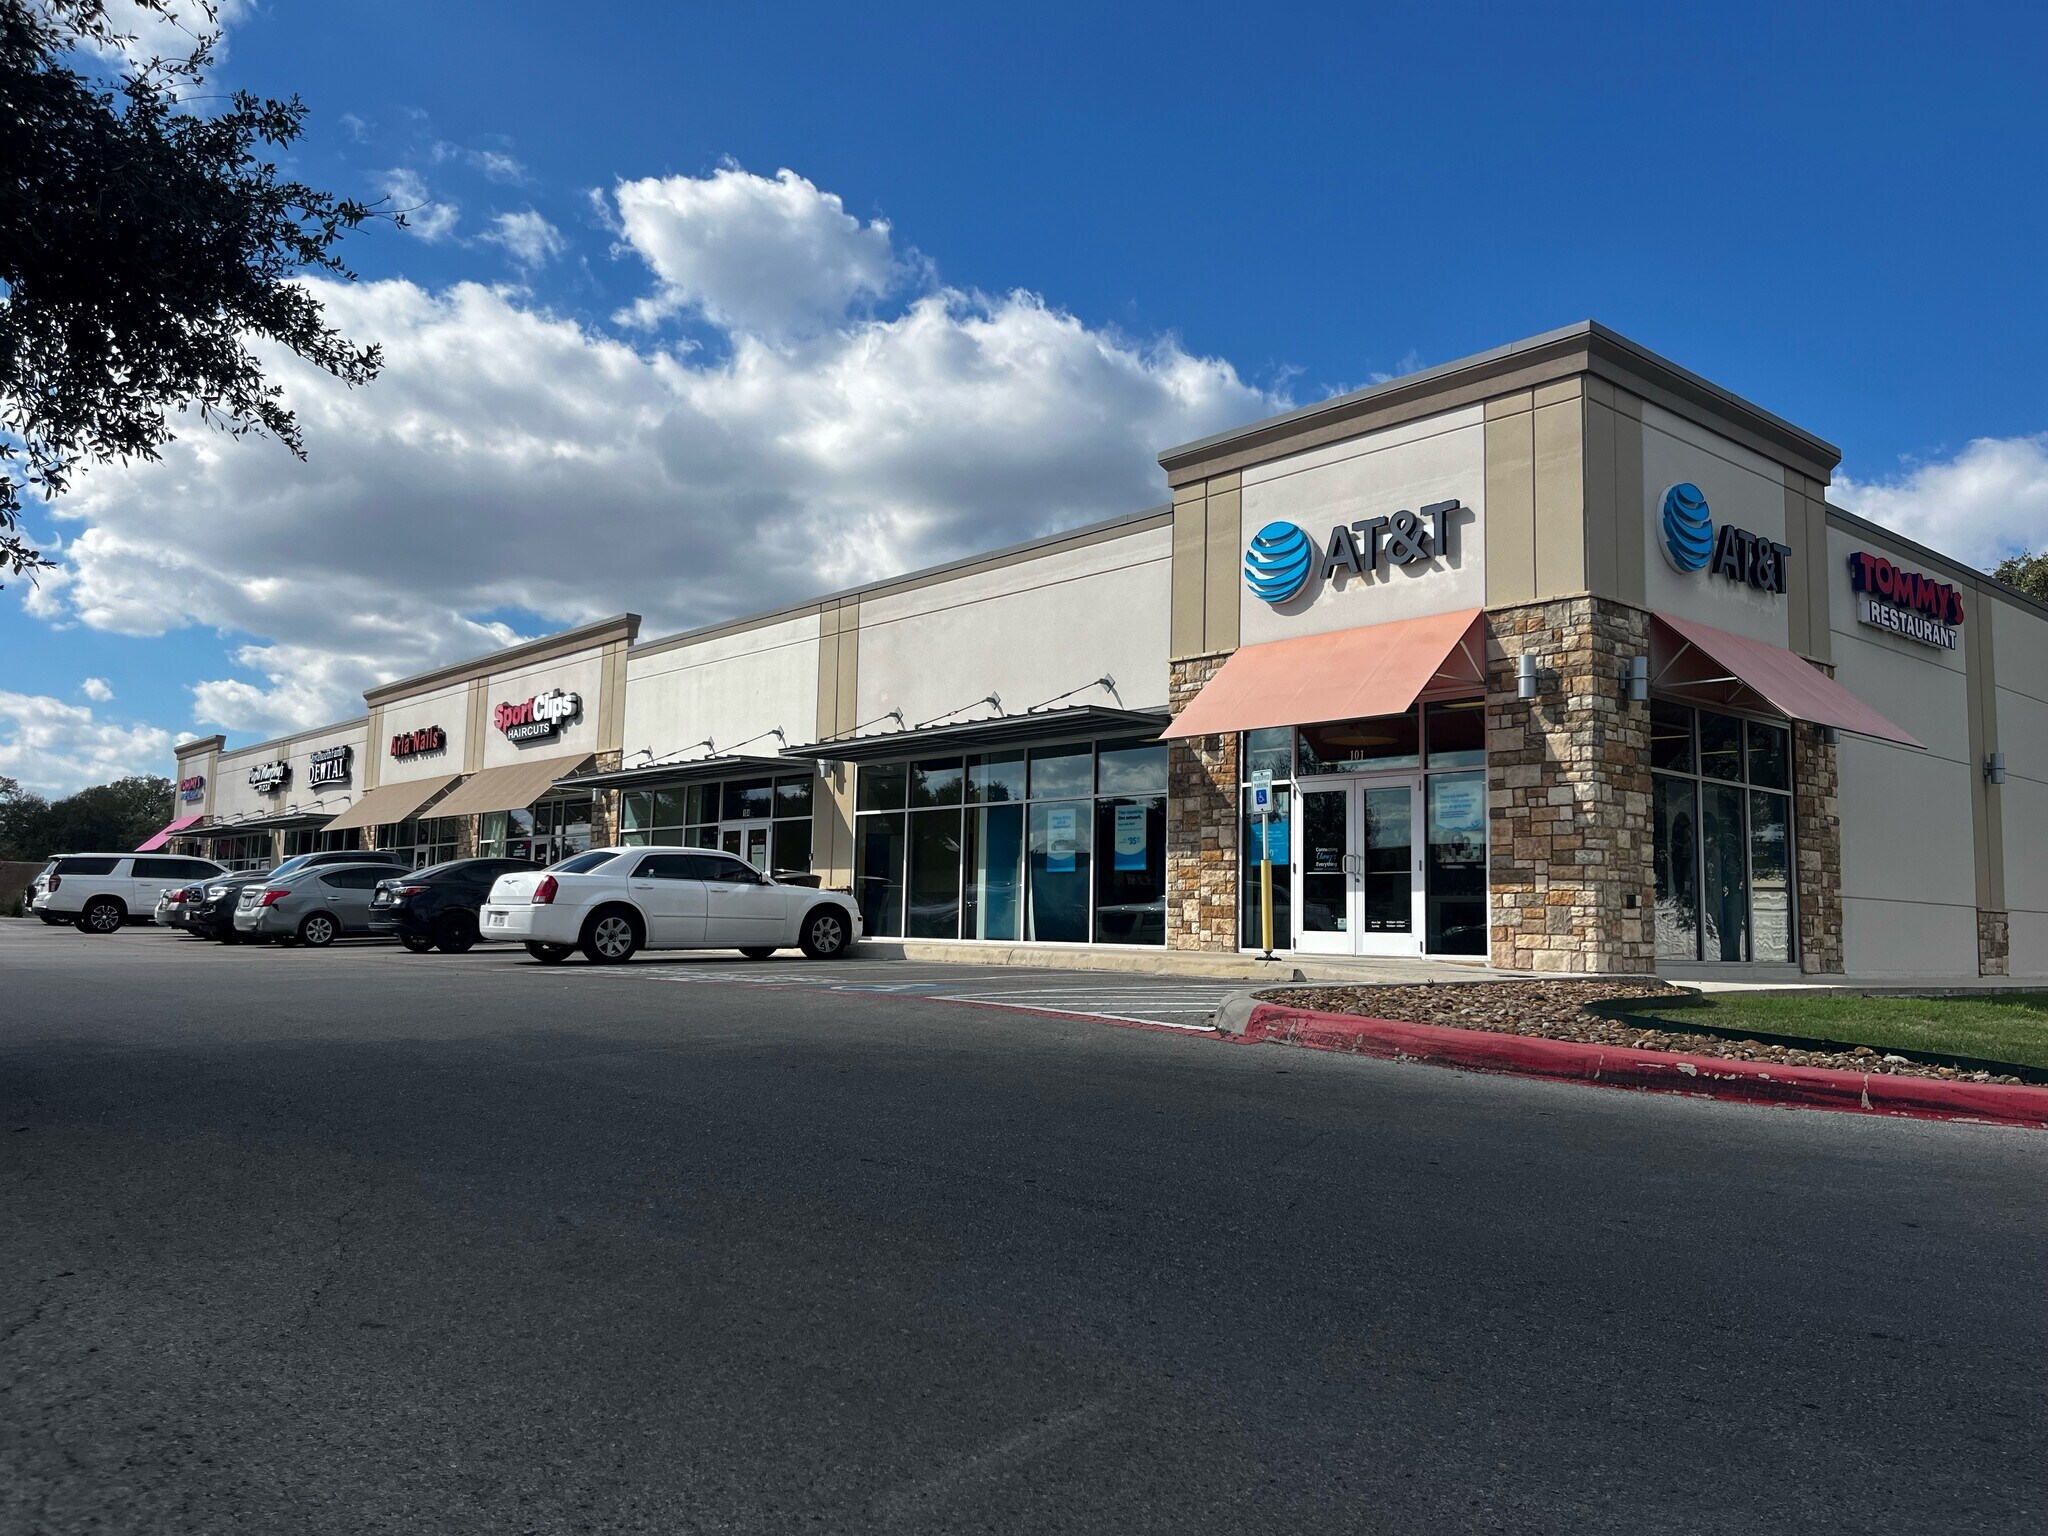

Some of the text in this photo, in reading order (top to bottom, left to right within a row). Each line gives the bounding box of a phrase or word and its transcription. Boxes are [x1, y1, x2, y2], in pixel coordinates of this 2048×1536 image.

[1320, 499, 1460, 579] AT&T
[1712, 524, 1792, 594] AT&T
[1851, 552, 1964, 625] TOMMY'S
[1870, 600, 1957, 651] RESTAURANT
[390, 728, 439, 756] Aria Nails
[508, 723, 550, 739] HAIRCUTS
[308, 758, 345, 783] DENTAL
[1350, 750, 1364, 761] 101
